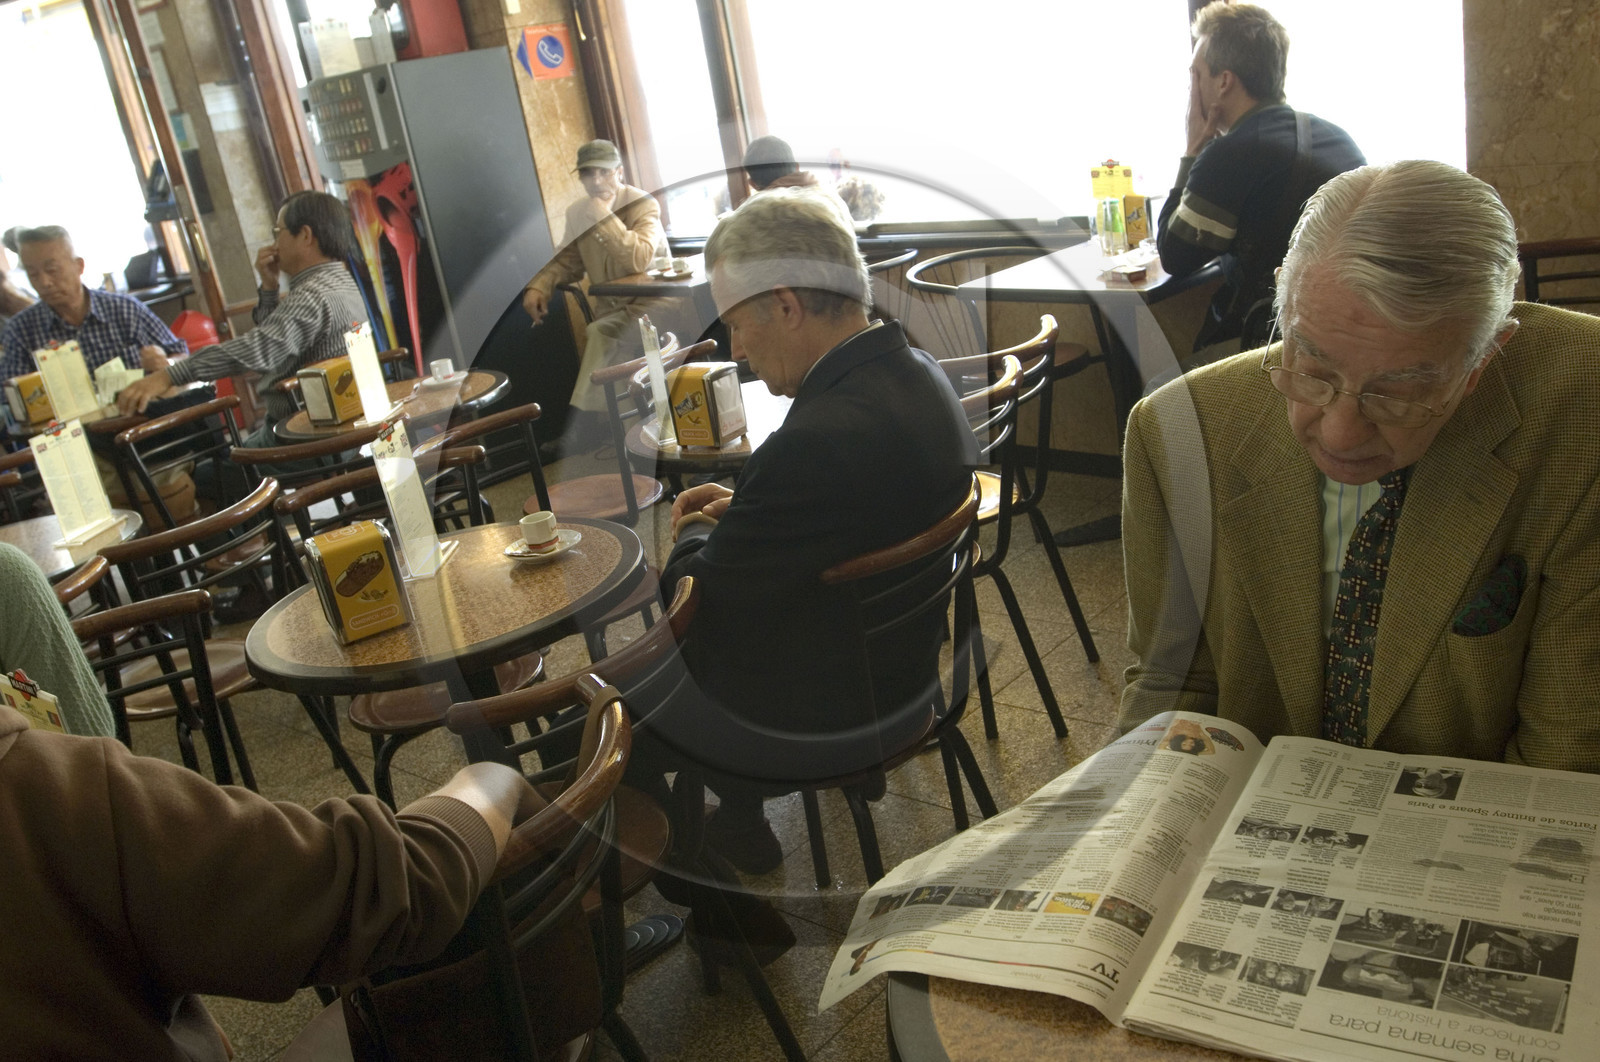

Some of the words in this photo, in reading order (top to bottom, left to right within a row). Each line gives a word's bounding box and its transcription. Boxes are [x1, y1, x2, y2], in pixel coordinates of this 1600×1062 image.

[1407, 800, 1436, 809] Paris
[1449, 805, 1490, 816] Spears
[1492, 809, 1535, 822] Britney
[1539, 816, 1555, 825] de
[1559, 819, 1597, 830] Fartos
[1521, 911, 1535, 919] hoje
[1537, 914, 1559, 922] recebe
[1561, 917, 1581, 926] Braga
[1089, 959, 1122, 984] TV
[1328, 1011, 1380, 1034] para
[1375, 1005, 1441, 1029] história
[1448, 1020, 1459, 1029] a
[1387, 1025, 1486, 1056] semana
[1466, 1022, 1561, 1052] conhecer
